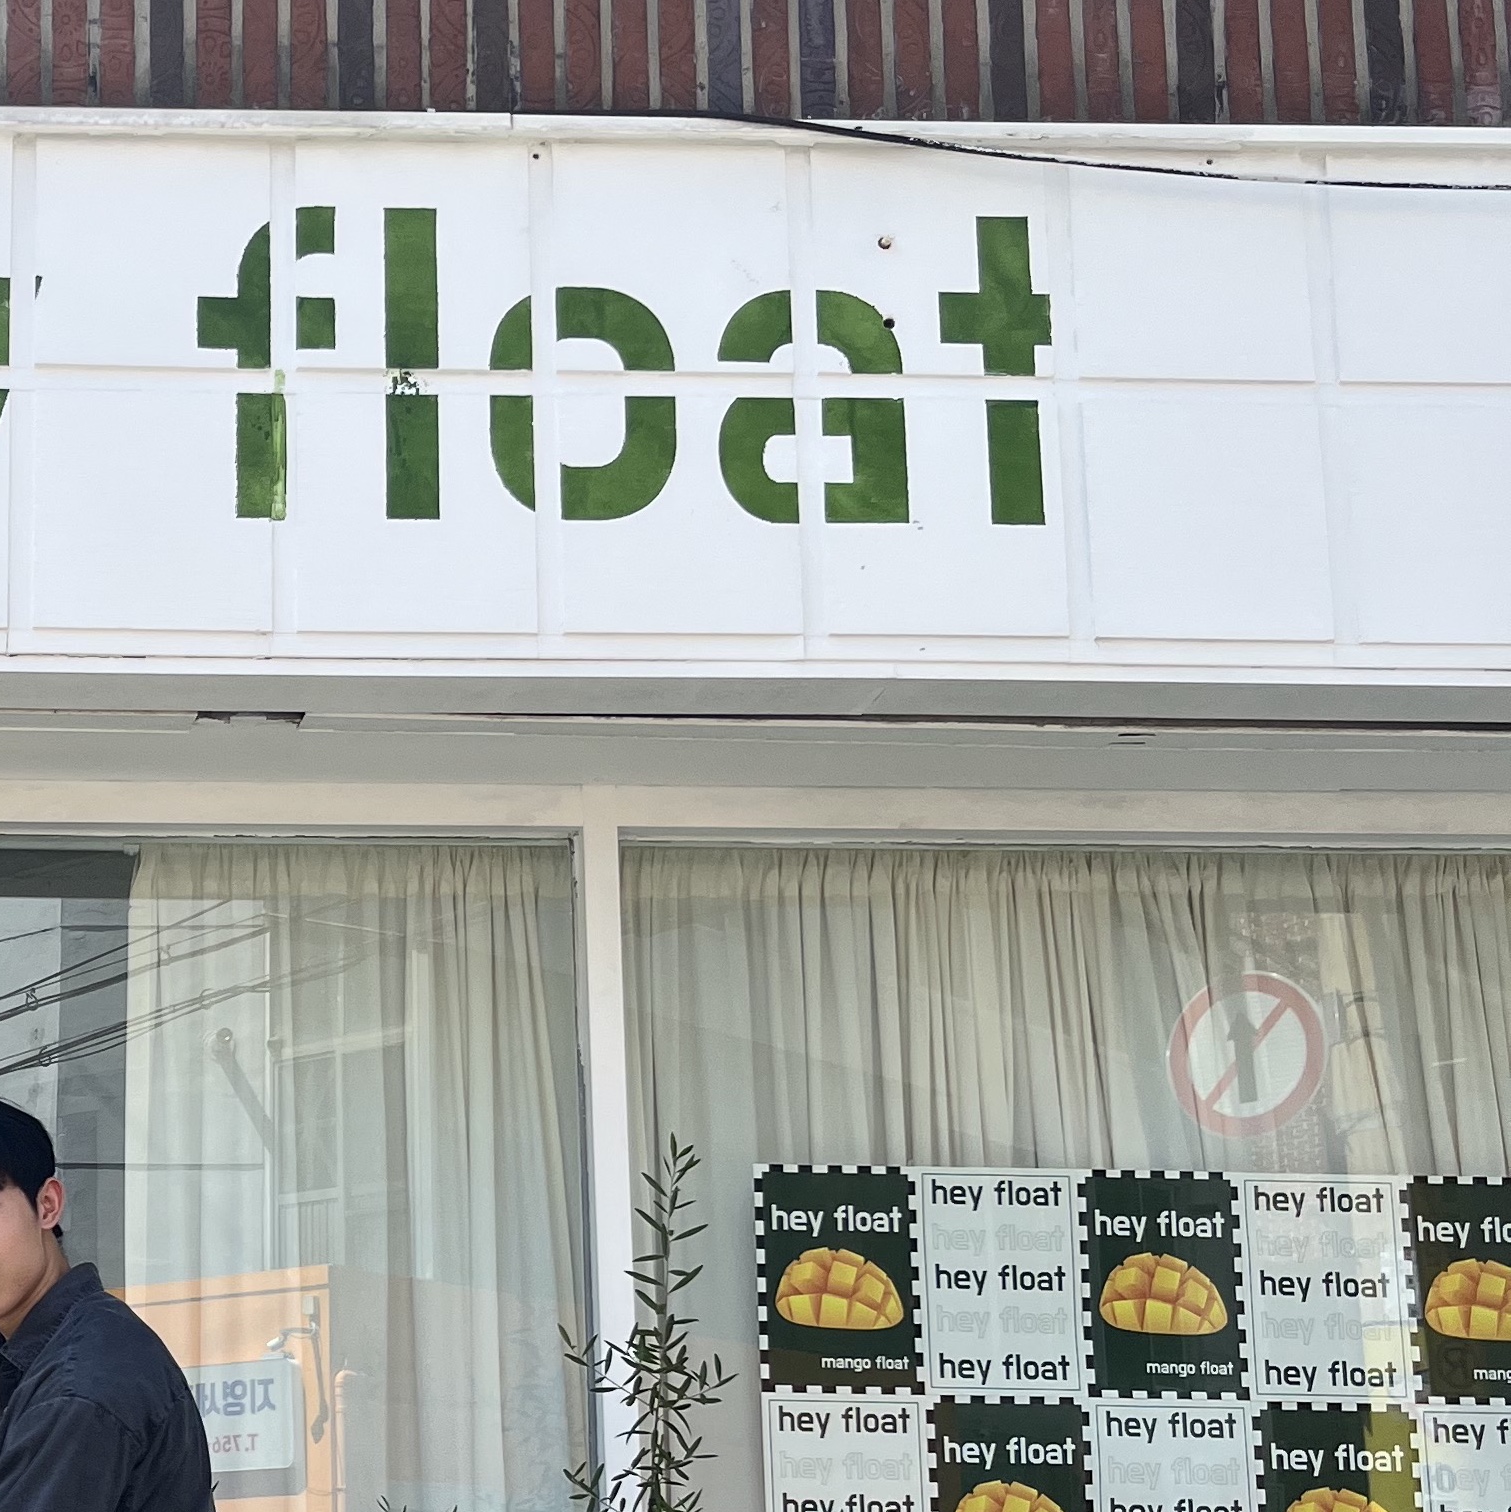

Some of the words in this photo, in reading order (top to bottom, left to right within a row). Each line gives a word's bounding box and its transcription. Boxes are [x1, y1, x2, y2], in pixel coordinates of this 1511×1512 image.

[197, 206, 1051, 525] float
[932, 1179, 982, 1211] hey
[994, 1181, 1061, 1206] float
[1254, 1186, 1305, 1217] hey
[1316, 1187, 1383, 1212] float
[771, 1204, 823, 1237] hey
[834, 1205, 902, 1232] float
[1095, 1209, 1147, 1242] hey
[1157, 1211, 1224, 1237] float
[1417, 1216, 1470, 1248] hey
[935, 1264, 987, 1295] hey
[999, 1265, 1065, 1291] float
[1260, 1270, 1310, 1302] hey
[1322, 1272, 1387, 1297] float
[822, 1358, 871, 1372] mango
[875, 1356, 909, 1369] float
[939, 1353, 991, 1385] hey
[1002, 1354, 1069, 1380] float
[1147, 1363, 1195, 1377] mango
[1200, 1361, 1233, 1375] float
[1265, 1360, 1317, 1392] hey
[1328, 1361, 1396, 1386] float
[779, 1406, 830, 1438] hey
[842, 1407, 909, 1433] float
[1106, 1411, 1156, 1443] hey
[1169, 1412, 1236, 1438] float
[1433, 1418, 1485, 1450] hey
[944, 1436, 996, 1469] hey
[1006, 1437, 1075, 1464] float
[1271, 1443, 1324, 1476] hey
[1335, 1444, 1404, 1472] float
